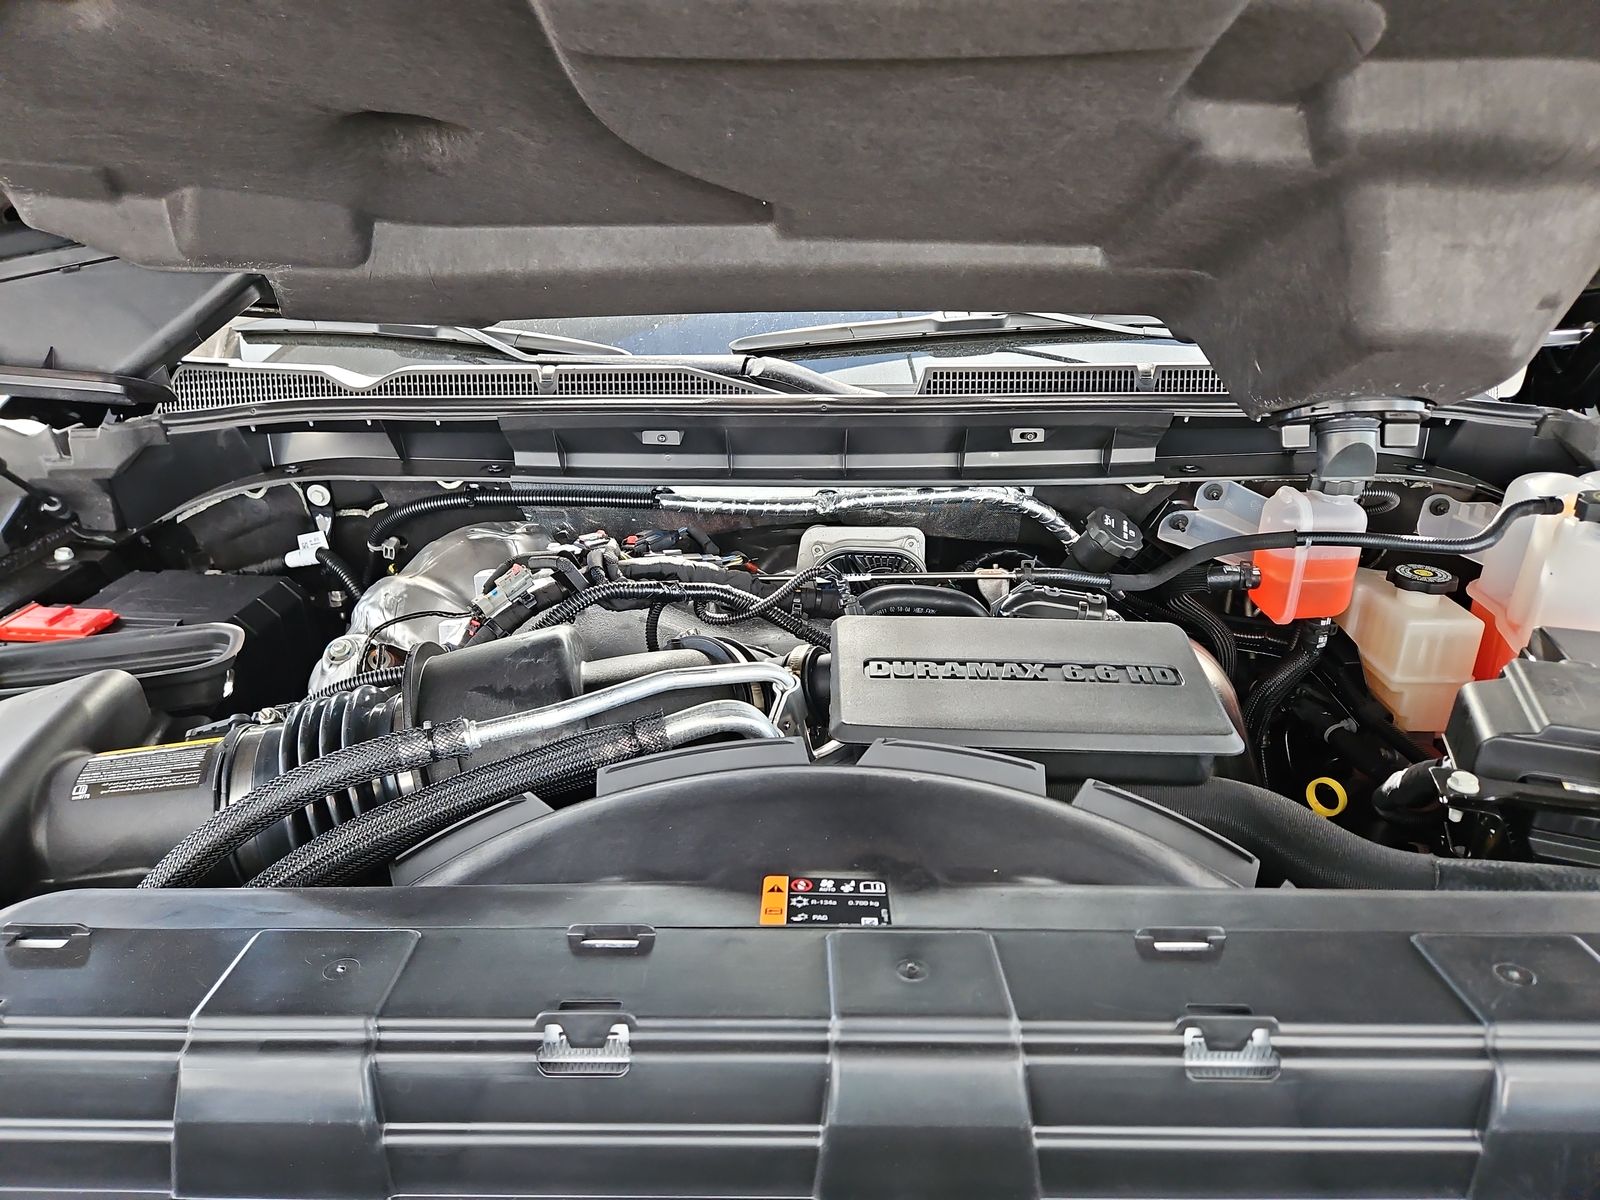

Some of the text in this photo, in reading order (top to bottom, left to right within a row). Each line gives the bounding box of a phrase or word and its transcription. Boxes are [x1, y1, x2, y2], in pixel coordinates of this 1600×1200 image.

[868, 660, 1180, 685] DURAMAX 6.6 HD
